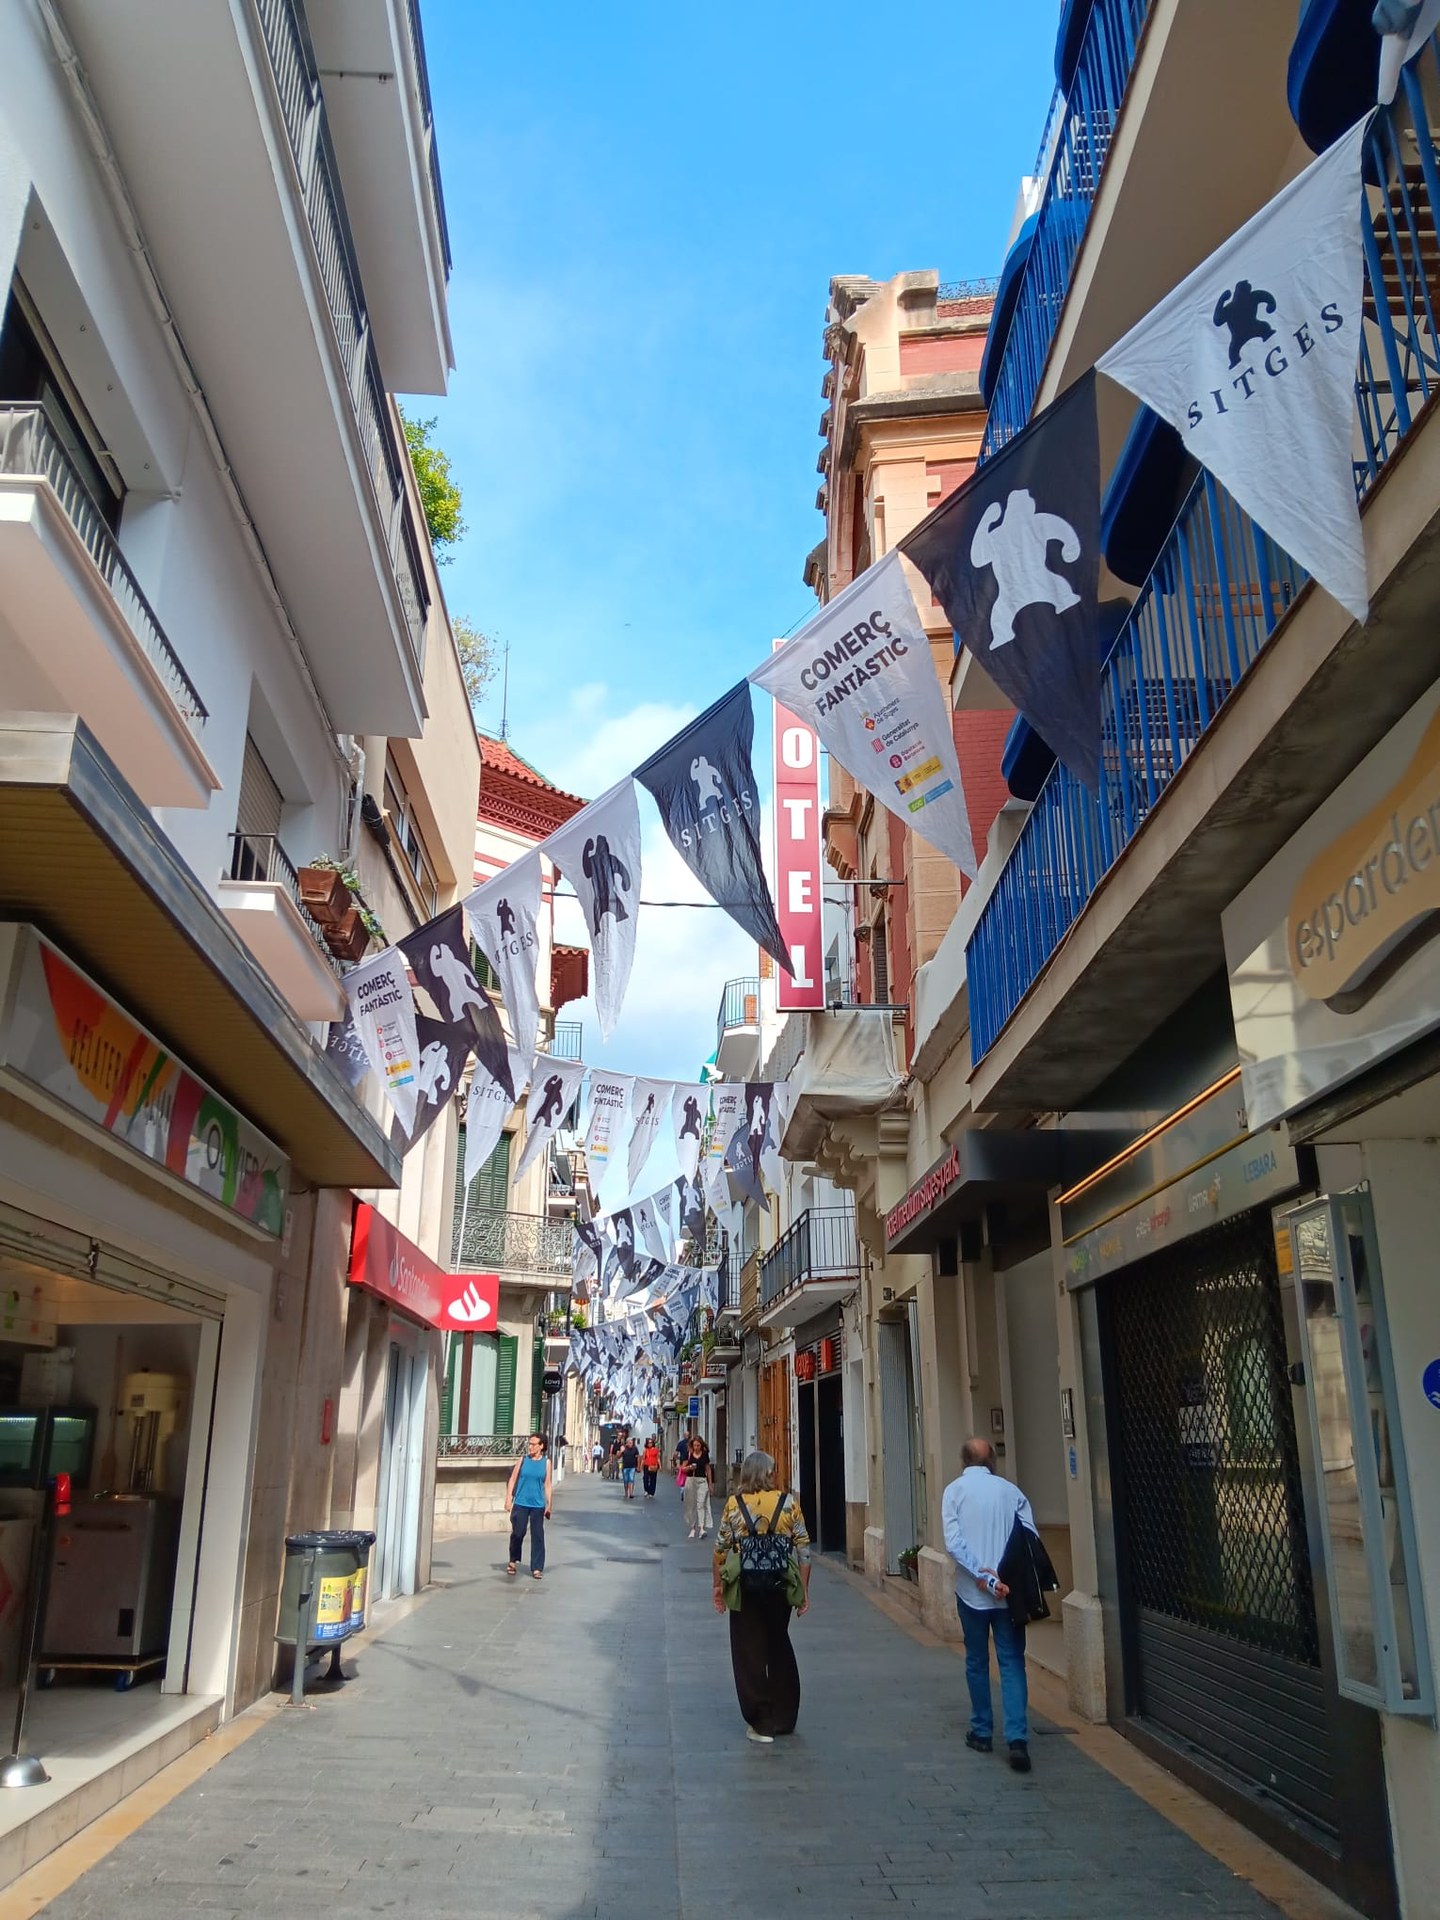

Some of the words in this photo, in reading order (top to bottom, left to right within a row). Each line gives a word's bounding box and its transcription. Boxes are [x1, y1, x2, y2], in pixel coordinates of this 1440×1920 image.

[1187, 302, 1344, 429] SITGES
[799, 610, 892, 692] COMERÇ
[814, 637, 909, 717] FANTÀSTIC
[882, 719, 913, 743] Generalitat
[886, 740, 895, 750] de
[894, 723, 922, 744] Catalunya
[681, 789, 753, 848] SITGES
[782, 727, 814, 988] OTEL
[357, 971, 396, 1000] COMERÇ
[360, 989, 403, 1017] FANTÀSTIC
[595, 1083, 625, 1100] COMERÇ
[1242, 1150, 1277, 1184] LEBARA
[1062, 1392, 1070, 1421] H
